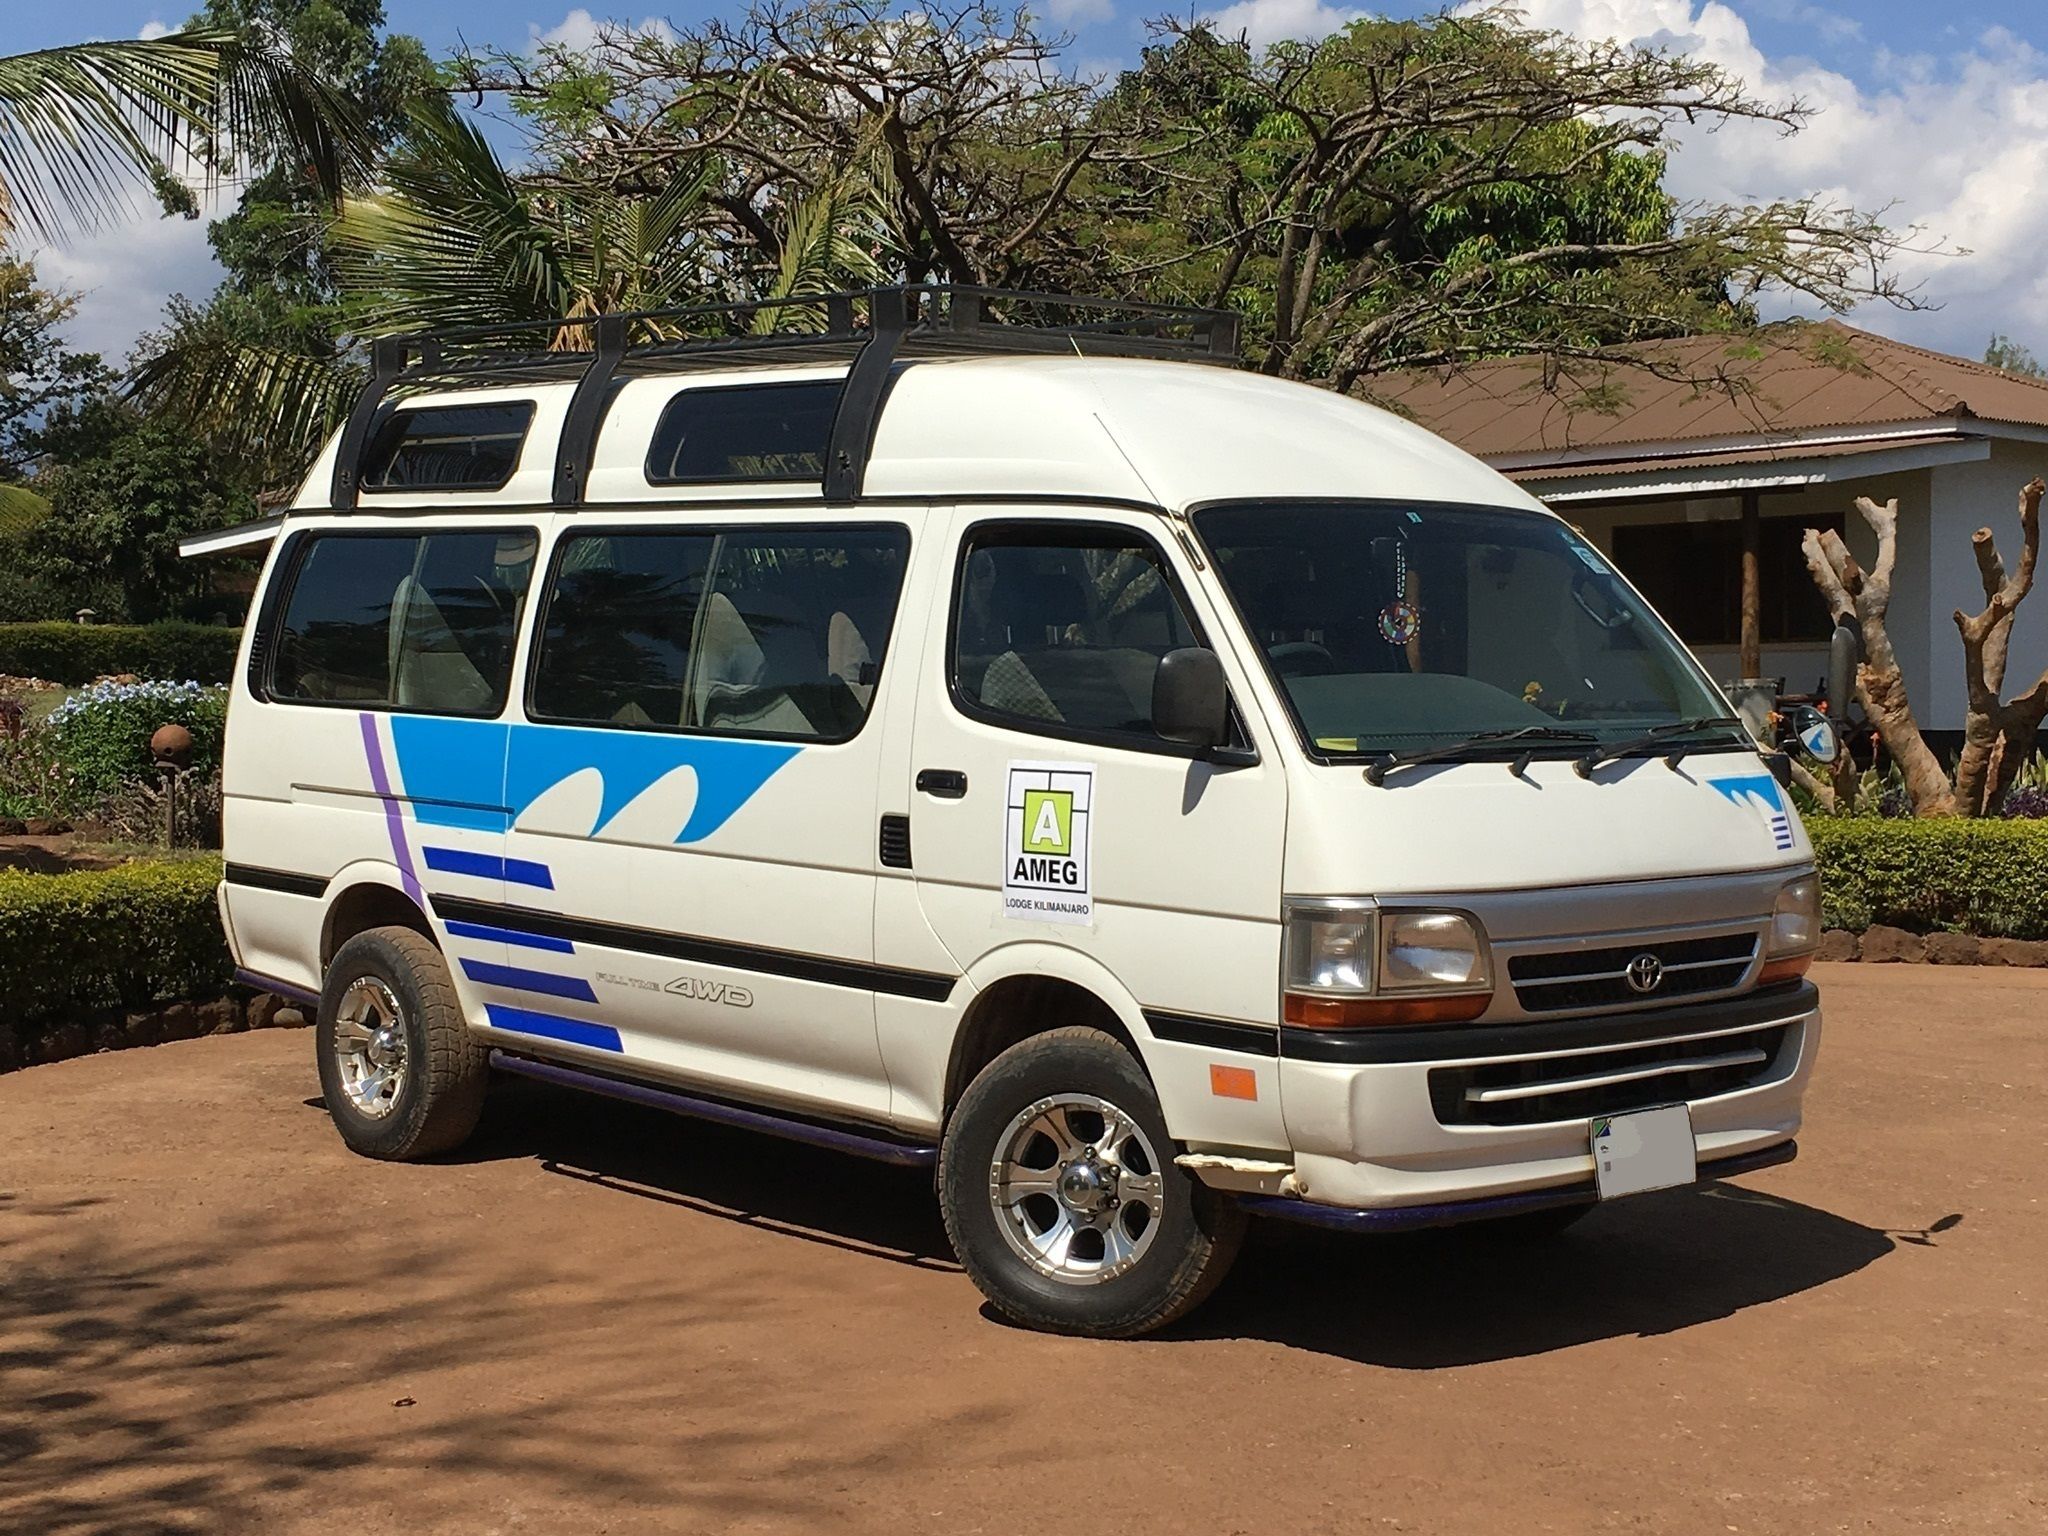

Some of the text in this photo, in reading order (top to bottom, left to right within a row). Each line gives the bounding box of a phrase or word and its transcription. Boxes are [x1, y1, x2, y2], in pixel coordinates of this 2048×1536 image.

[1030, 798, 1064, 847] A
[1013, 857, 1078, 886] AMEG
[1005, 897, 1089, 915] LODGE KILIMANJARO
[664, 976, 754, 1008] 4WD
